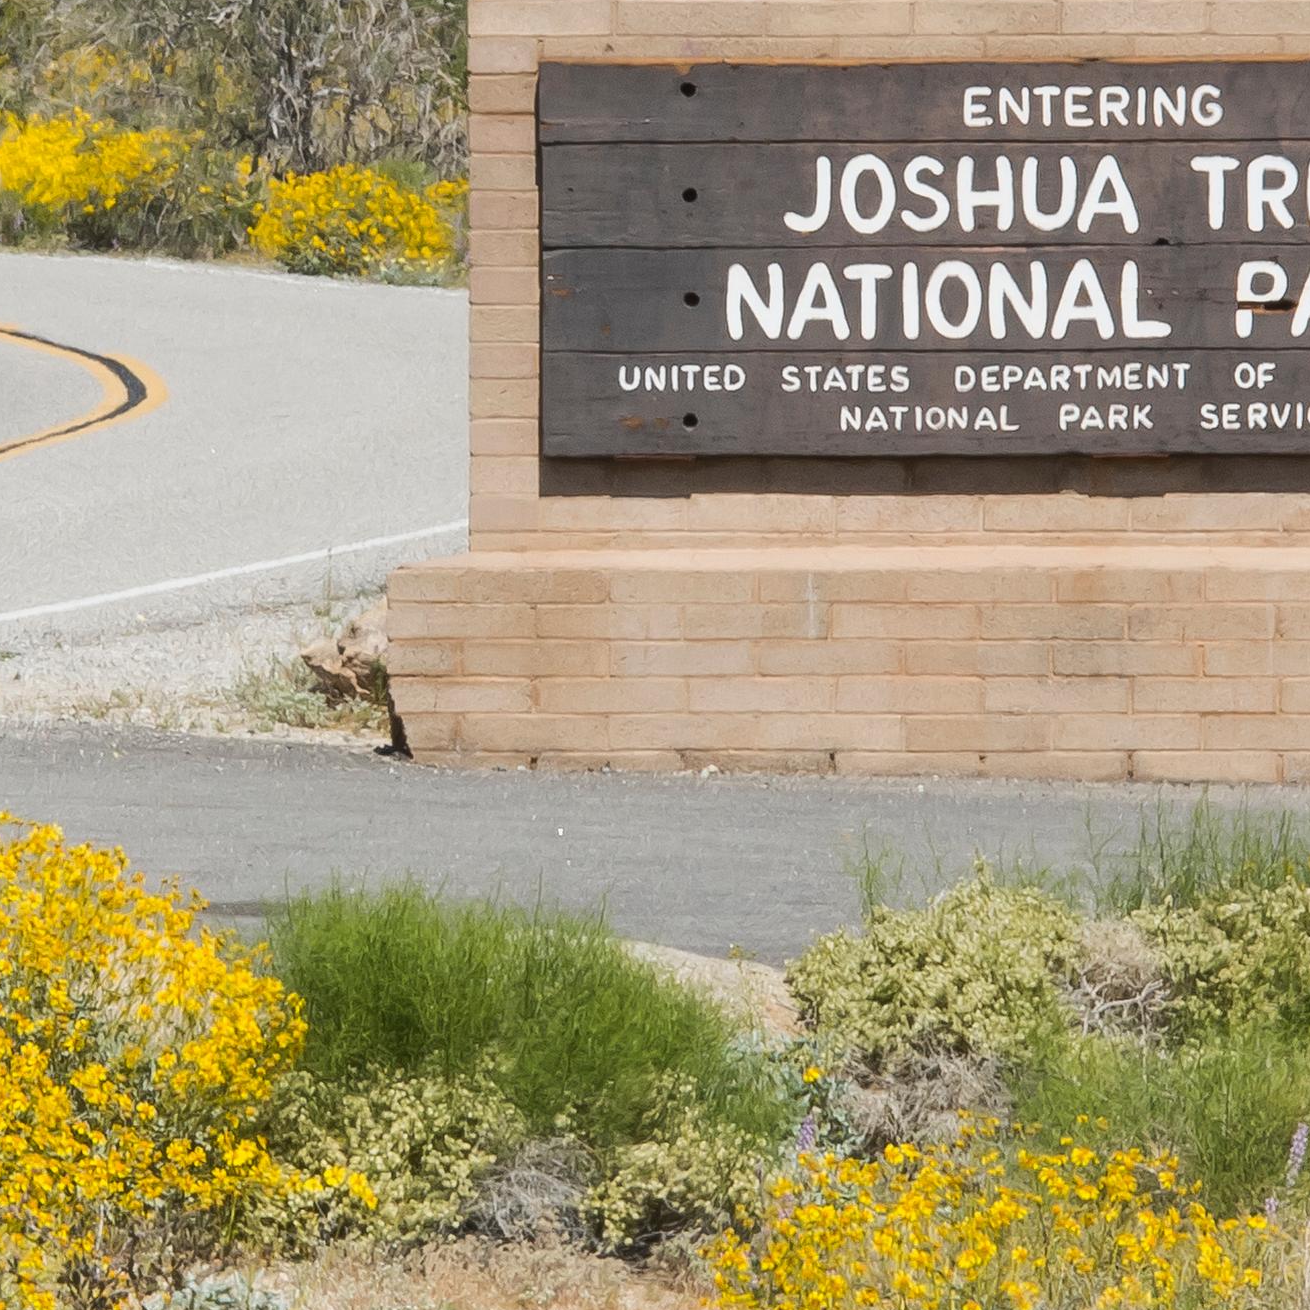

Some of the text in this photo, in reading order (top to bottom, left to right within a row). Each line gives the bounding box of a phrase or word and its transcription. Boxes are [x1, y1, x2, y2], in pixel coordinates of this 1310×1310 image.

[963, 84, 1223, 128] ENTERING
[783, 153, 1140, 235] JOSHUA
[725, 258, 1172, 341] NATIONAL
[618, 364, 746, 392] UNITED
[781, 364, 910, 393] STATES
[954, 362, 1191, 393] DEPARTMENT
[1234, 362, 1276, 390] OF
[840, 404, 1020, 432] NATIONAL
[1059, 403, 1154, 431] PARK
